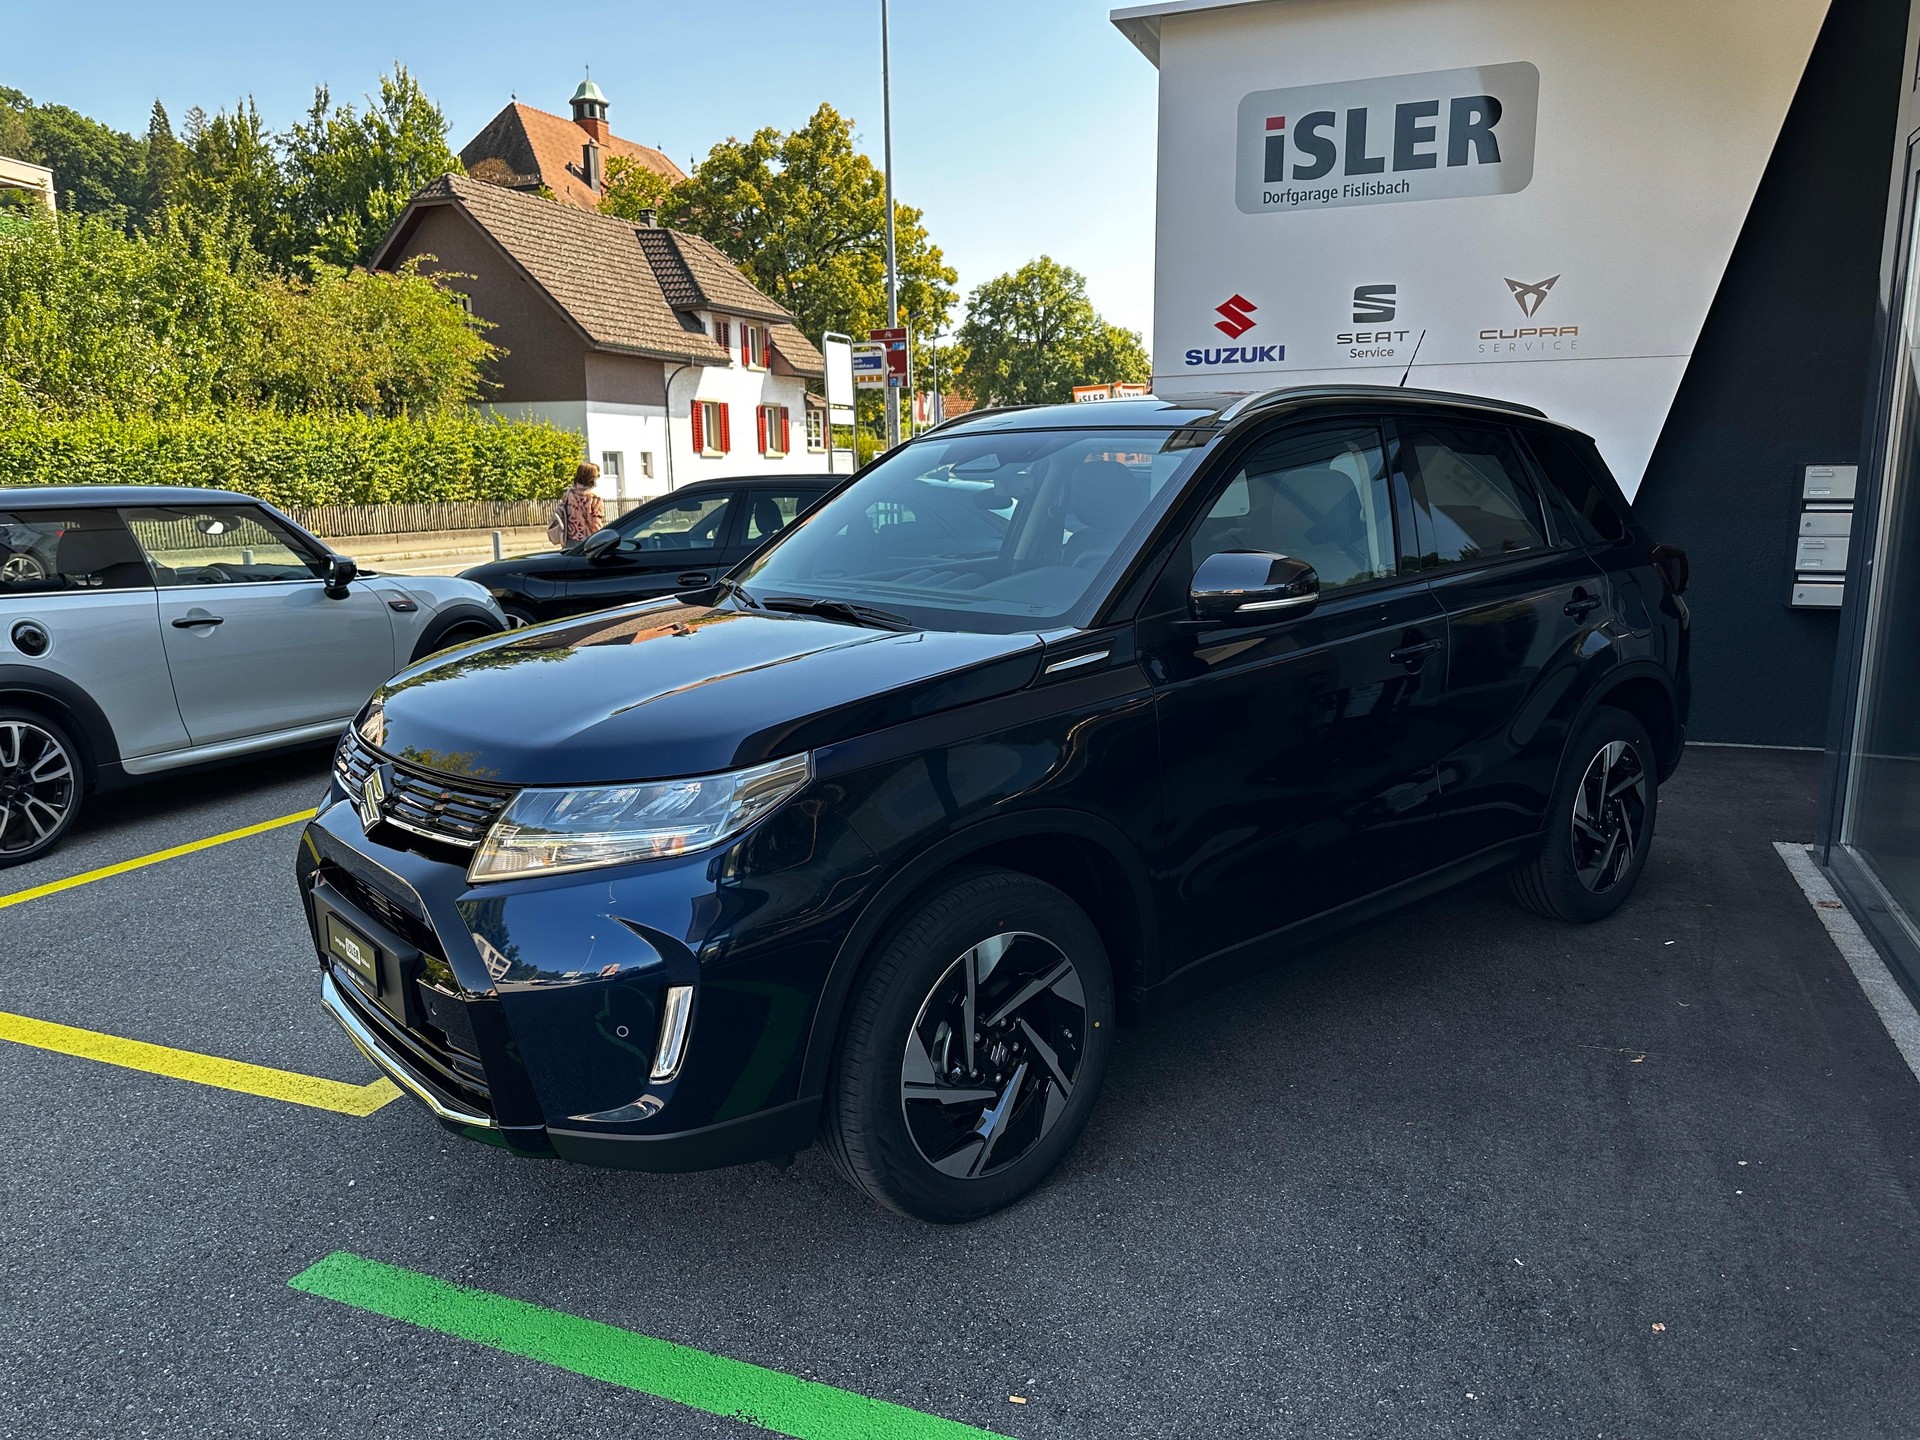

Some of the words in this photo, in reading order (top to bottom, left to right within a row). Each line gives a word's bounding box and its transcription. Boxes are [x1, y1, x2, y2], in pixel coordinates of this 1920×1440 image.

[1262, 185, 1339, 205] Dorfgarage
[1342, 178, 1411, 199] Fislisbach
[1336, 330, 1410, 345] SEAT
[1479, 326, 1579, 340] CUPRA
[1349, 347, 1395, 359] Service
[1478, 340, 1578, 354] SERVICE
[1184, 345, 1286, 366] SUZUKI
